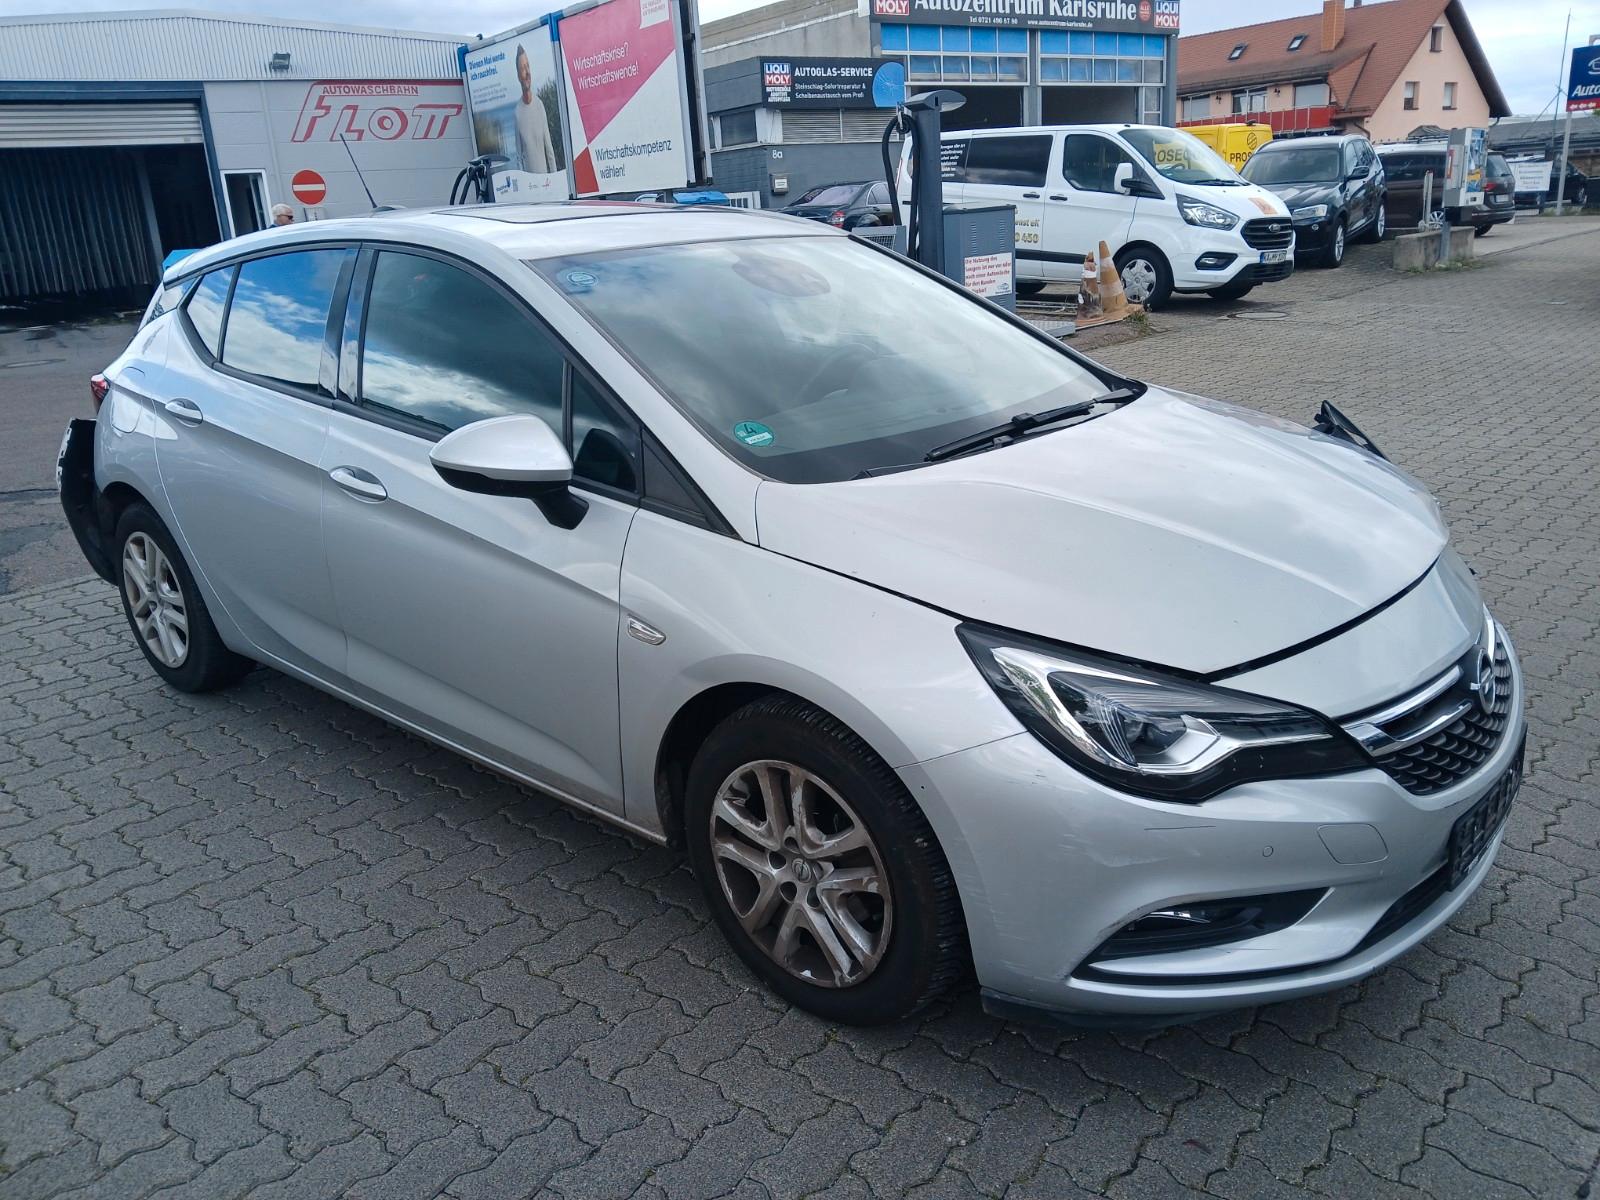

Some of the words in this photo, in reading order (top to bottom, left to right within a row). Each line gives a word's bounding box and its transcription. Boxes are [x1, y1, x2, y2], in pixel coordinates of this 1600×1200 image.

[876, 0, 908, 14] MOLY
[914, 0, 1044, 16] Autozentrum
[1050, 0, 1137, 20] Karlsruhe
[1156, 1, 1179, 14] LIQUI
[1156, 15, 1179, 27] MOLY
[573, 41, 629, 71] Wirtschaftskrise?
[578, 60, 639, 90] Wirtschaftswende!
[765, 64, 790, 74] LIQUI
[794, 67, 873, 77] AUTOGLAS-SERVICE
[766, 74, 790, 84] MOLY
[322, 85, 419, 96] AUTOWASCHBAHN
[291, 88, 463, 143] FLOTT
[595, 139, 672, 161] Wirtschaftskompetenz
[772, 149, 783, 159] 8a
[600, 164, 626, 179] wählen!
[1021, 232, 1039, 243] 450
